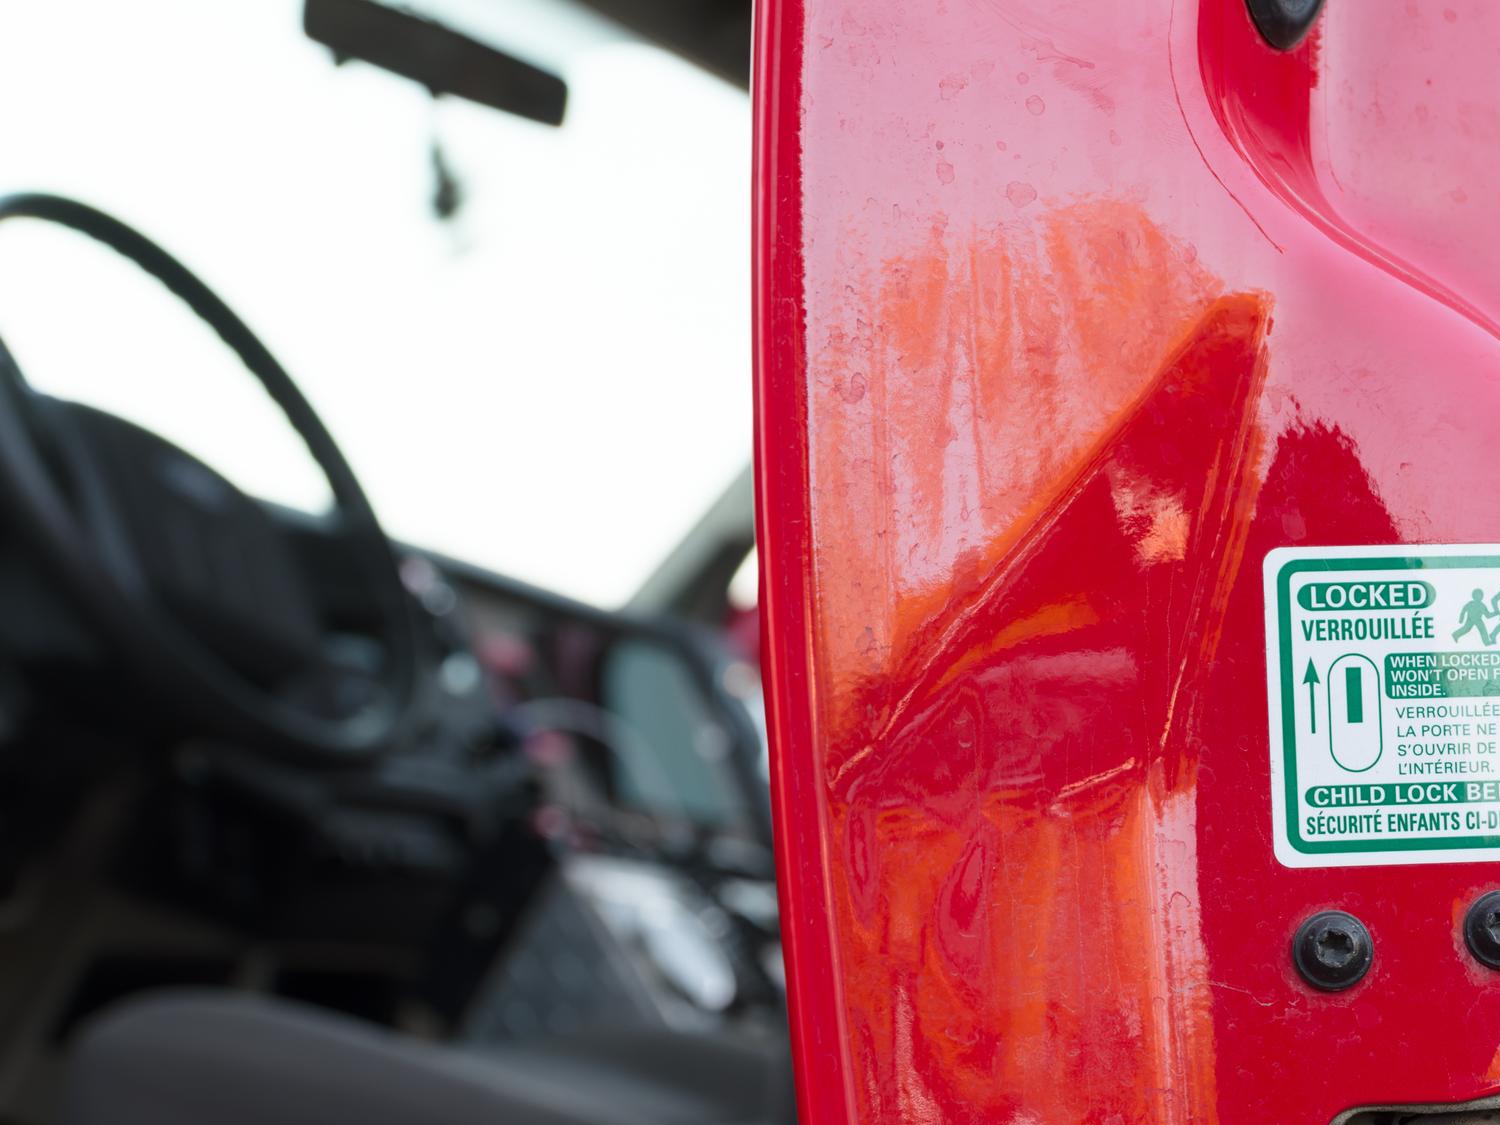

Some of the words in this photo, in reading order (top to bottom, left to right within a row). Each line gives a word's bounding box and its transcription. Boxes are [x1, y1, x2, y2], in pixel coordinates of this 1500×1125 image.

[1310, 584, 1428, 608] LOCKED
[1301, 611, 1435, 641] VERROUILLÉE
[1390, 655, 1437, 668] WHEN
[1391, 669, 1443, 682] WON'T
[1447, 668, 1489, 681] OPEN
[1391, 683, 1446, 697] INSIDE.
[1395, 702, 1500, 719] VERROUILLÉE
[1397, 725, 1416, 738] LA
[1422, 723, 1471, 737] PORTE
[1477, 723, 1497, 736] NE
[1398, 743, 1472, 757] S'OUVRIR
[1477, 742, 1497, 754] DE
[1399, 759, 1495, 775] L'INTÉRIEUR.
[1313, 786, 1386, 807] CHILD
[1395, 783, 1458, 804] LOCK
[1306, 809, 1383, 836] SÉCURITÉ
[1388, 811, 1460, 833] ENFANTS
